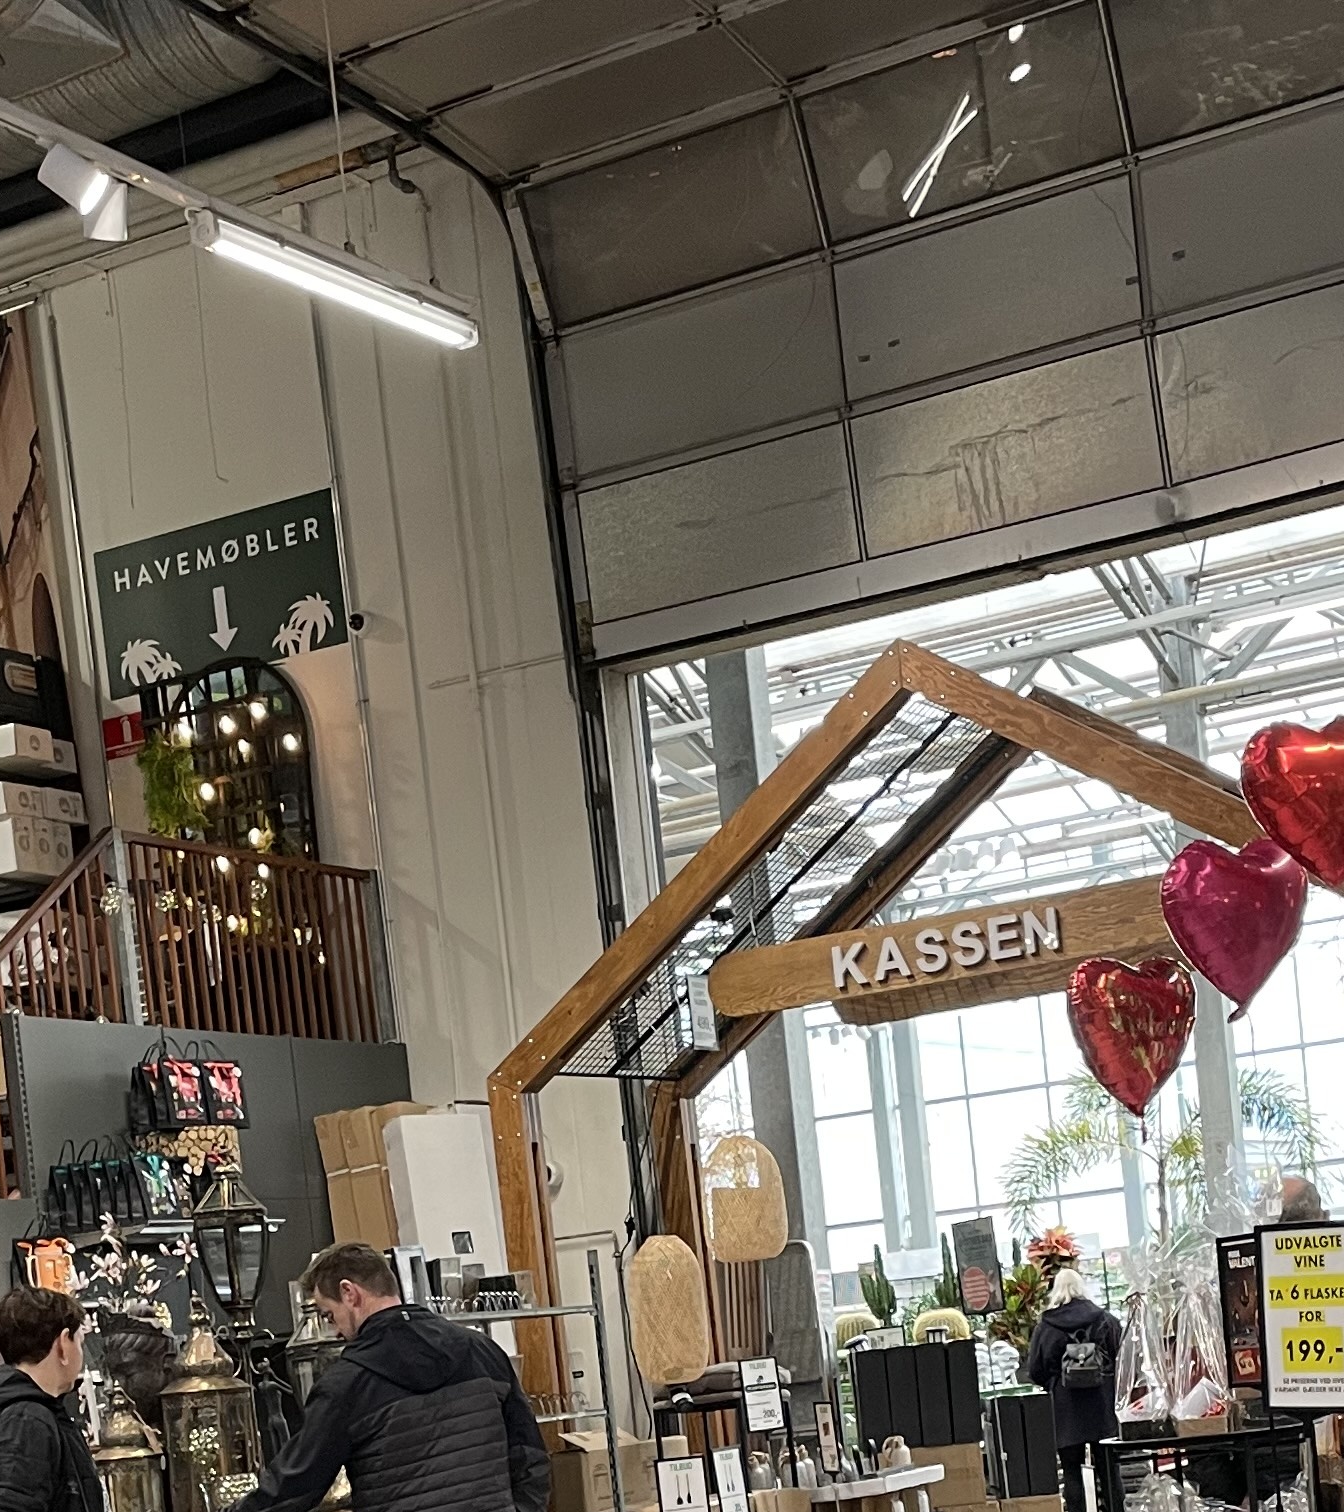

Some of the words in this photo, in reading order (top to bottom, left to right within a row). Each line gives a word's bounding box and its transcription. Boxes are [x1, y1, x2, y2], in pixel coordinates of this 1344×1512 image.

[113, 517, 321, 593] HAVEMØBLER
[832, 907, 1060, 989] KASSEN
[1274, 1235, 1342, 1250] UDVALGTE
[1228, 1256, 1255, 1269] VALENT
[1294, 1255, 1325, 1268] VINE
[1269, 1289, 1284, 1301] TA
[1290, 1284, 1299, 1300] 6
[1286, 1339, 1344, 1363] 199,-
